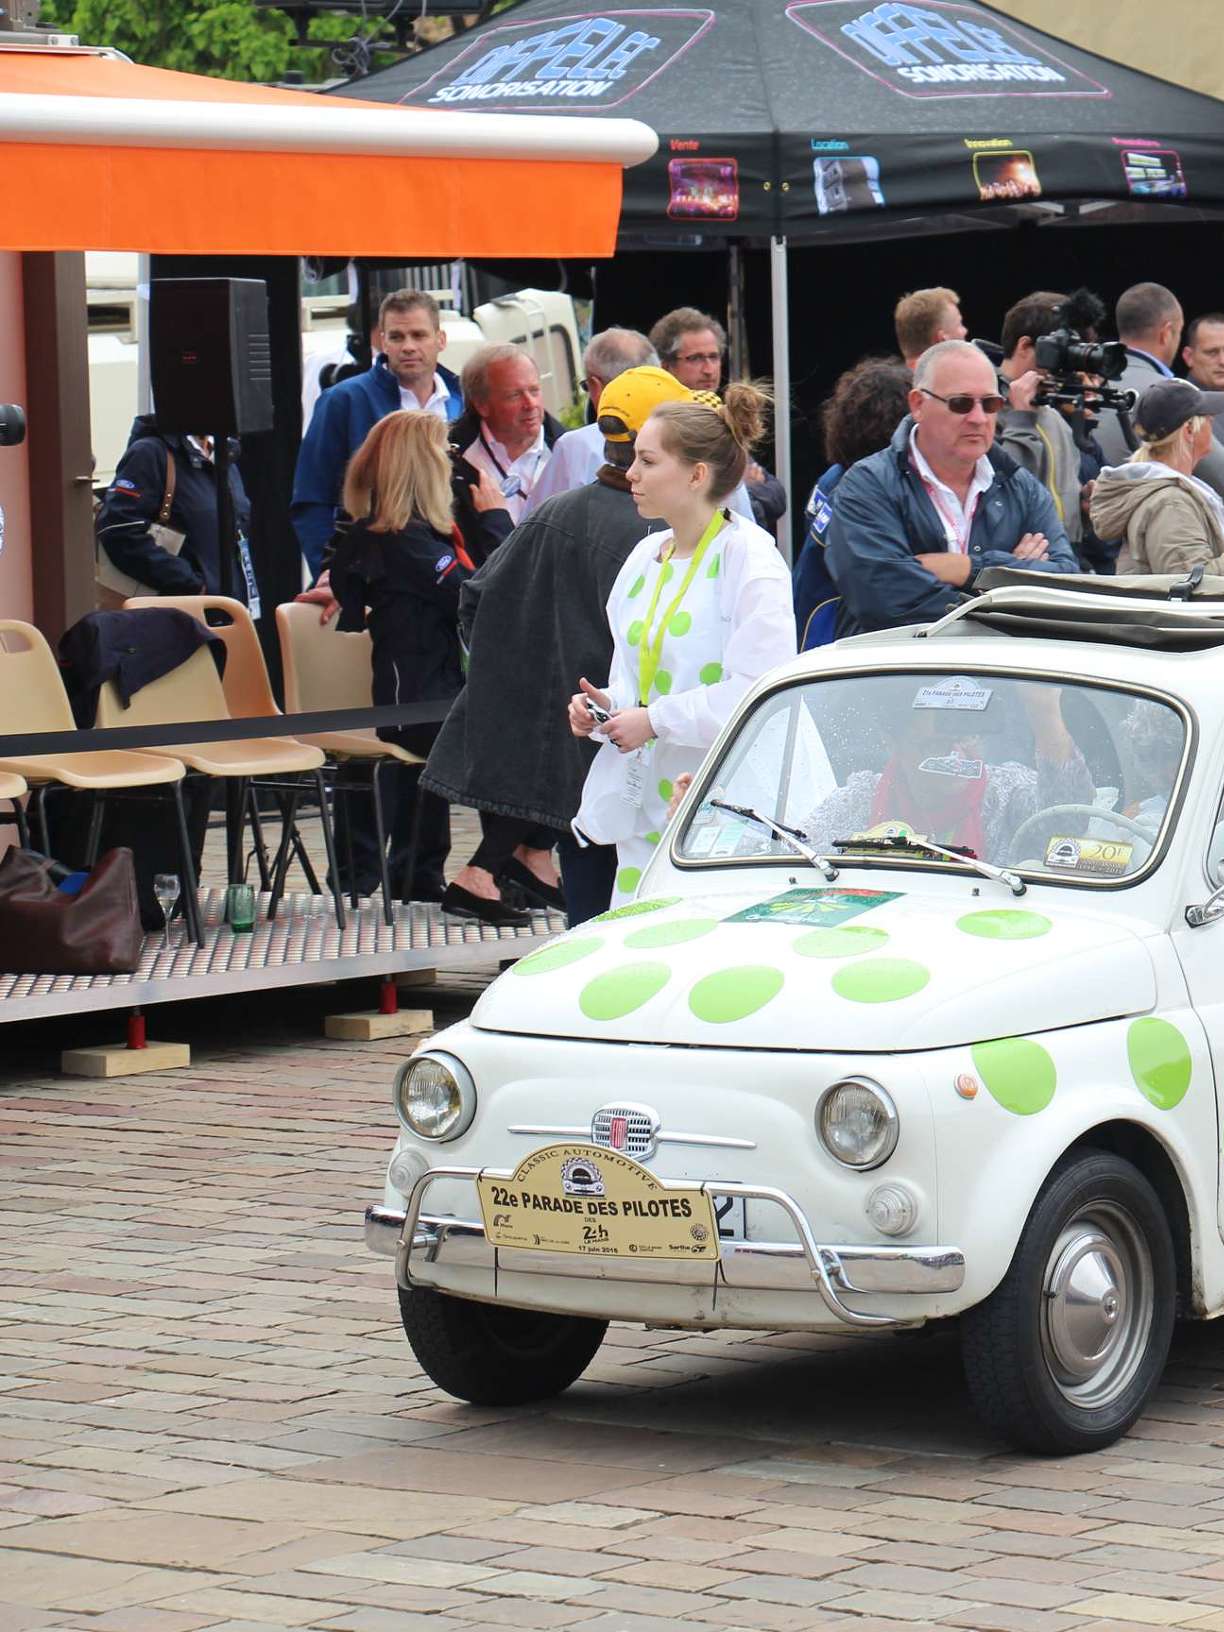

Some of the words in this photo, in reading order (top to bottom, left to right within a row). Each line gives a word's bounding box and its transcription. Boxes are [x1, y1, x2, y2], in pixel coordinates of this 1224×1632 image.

[427, 79, 615, 103] SONORISATION
[517, 1150, 560, 1183] CLASSIC
[563, 1149, 658, 1191] AUTOMOTIVE
[490, 1185, 519, 1208] 22e
[521, 1191, 584, 1215] PARADE
[587, 1200, 619, 1217] DES
[622, 1198, 693, 1218] PILOTES
